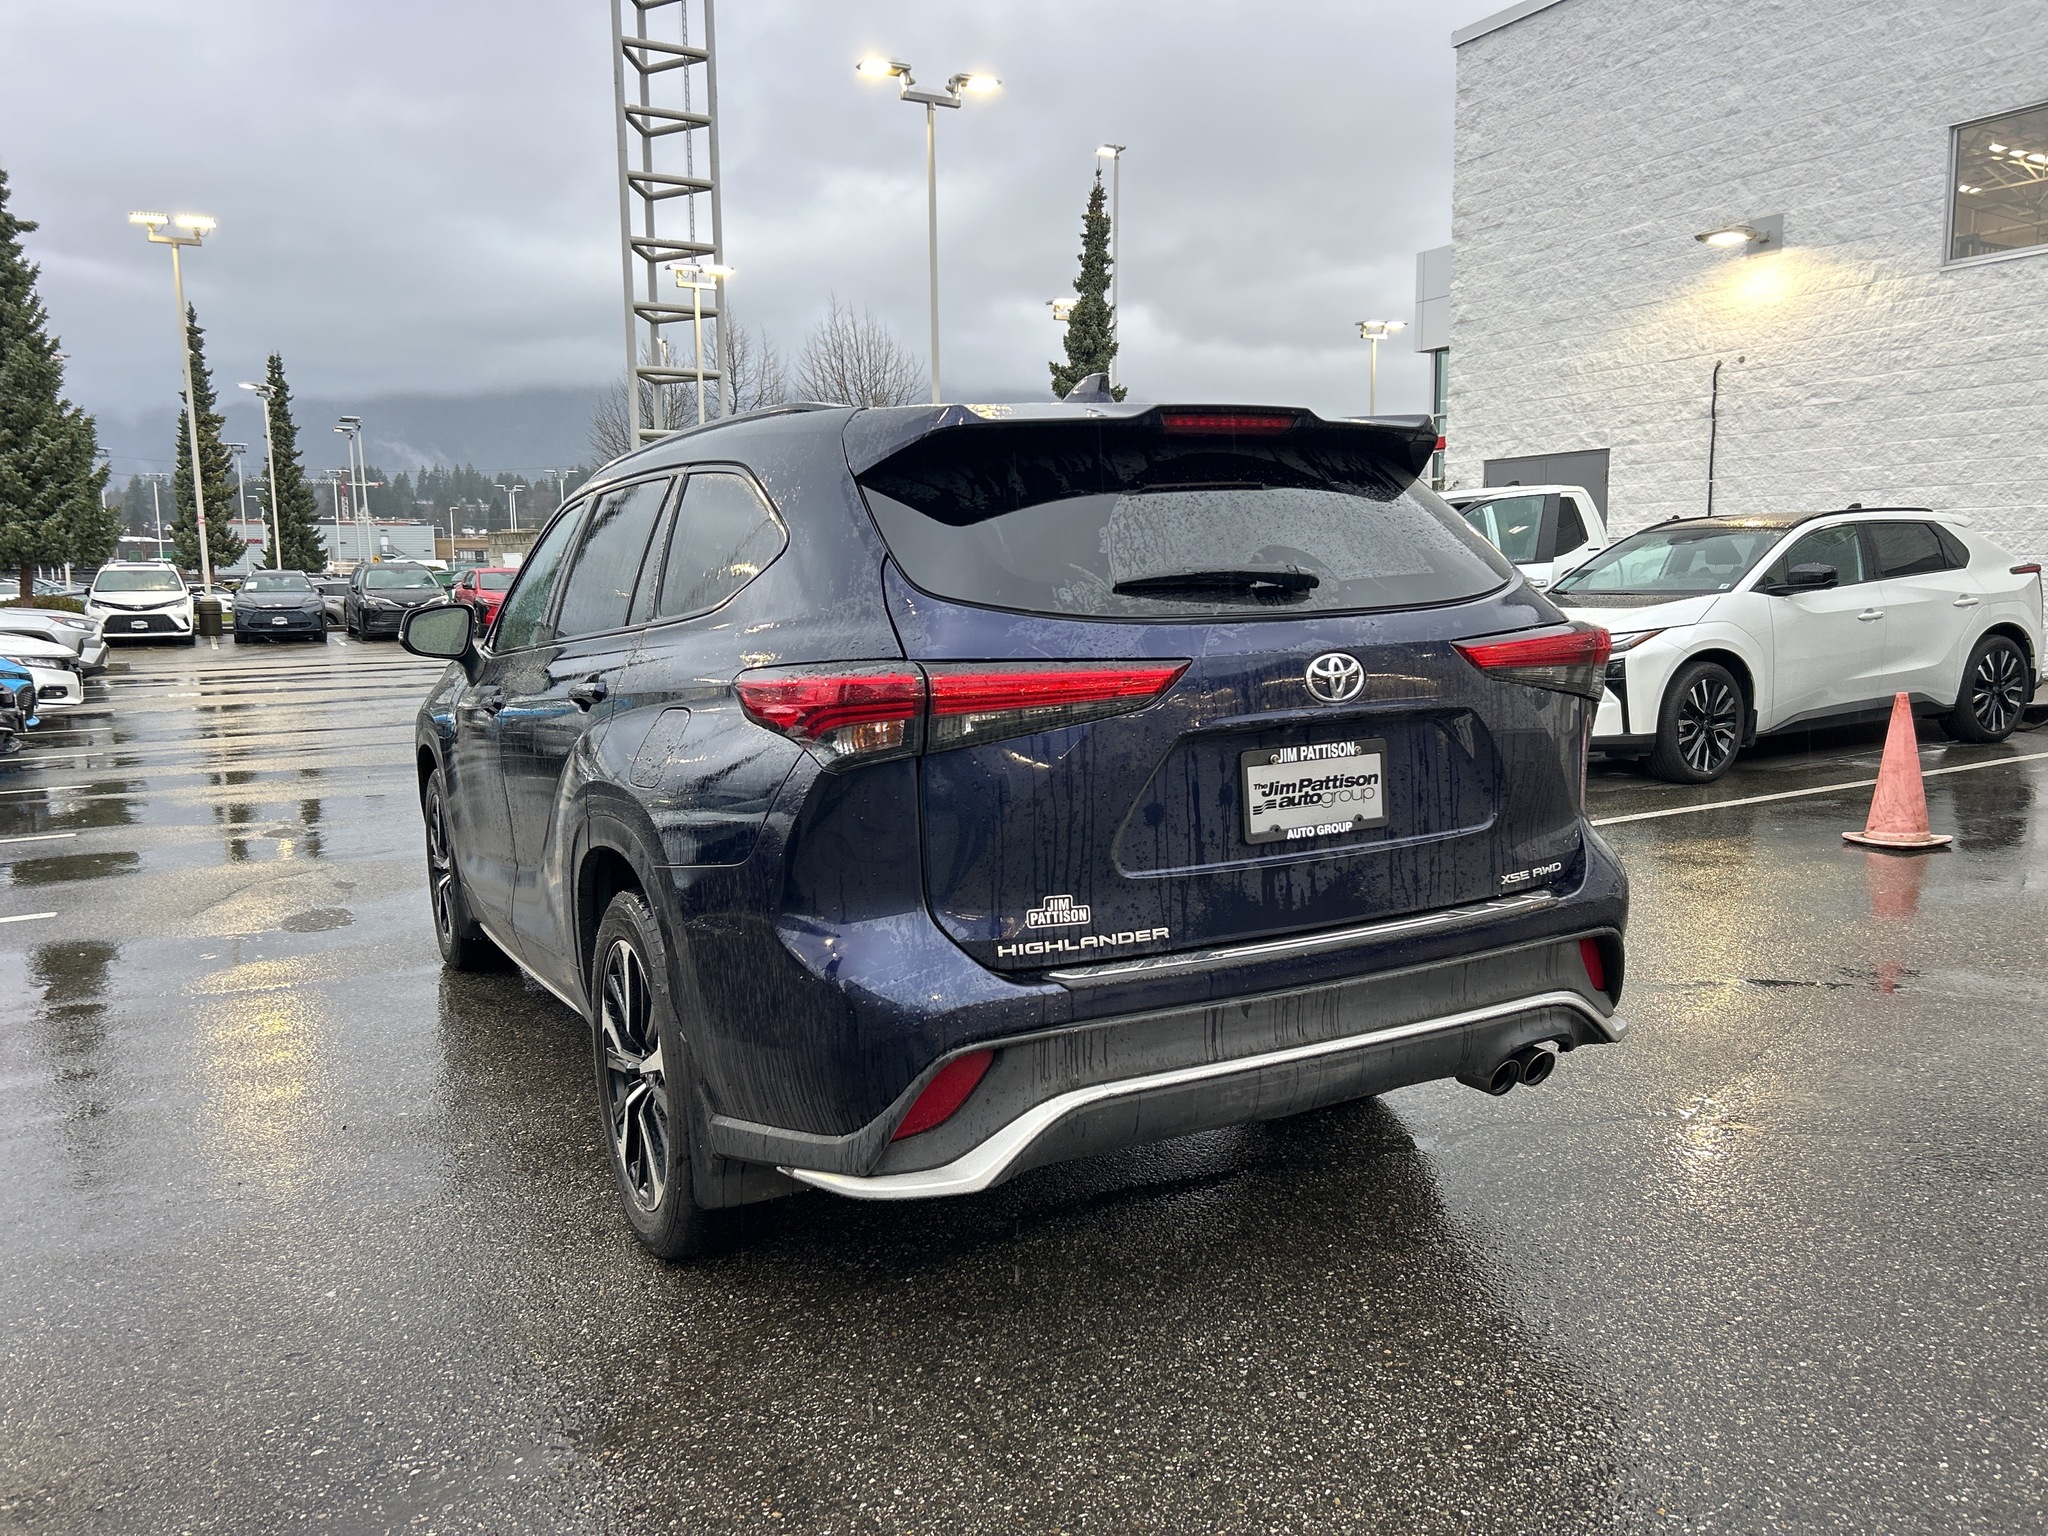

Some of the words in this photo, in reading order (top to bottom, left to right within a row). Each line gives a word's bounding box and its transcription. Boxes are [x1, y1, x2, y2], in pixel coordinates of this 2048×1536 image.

[1278, 747, 1298, 764] JIM
[1300, 741, 1356, 761] PATTISON
[1261, 781, 1297, 797] Jim
[1298, 774, 1379, 793] Pattison
[1287, 827, 1315, 840] AUTO
[1317, 821, 1353, 836] GROUP
[1500, 869, 1530, 885] XSE
[1532, 862, 1562, 878] AWD
[1047, 898, 1070, 912] JIM
[1030, 908, 1087, 926] PATTISON
[997, 927, 1170, 957] HIGHLANDER
